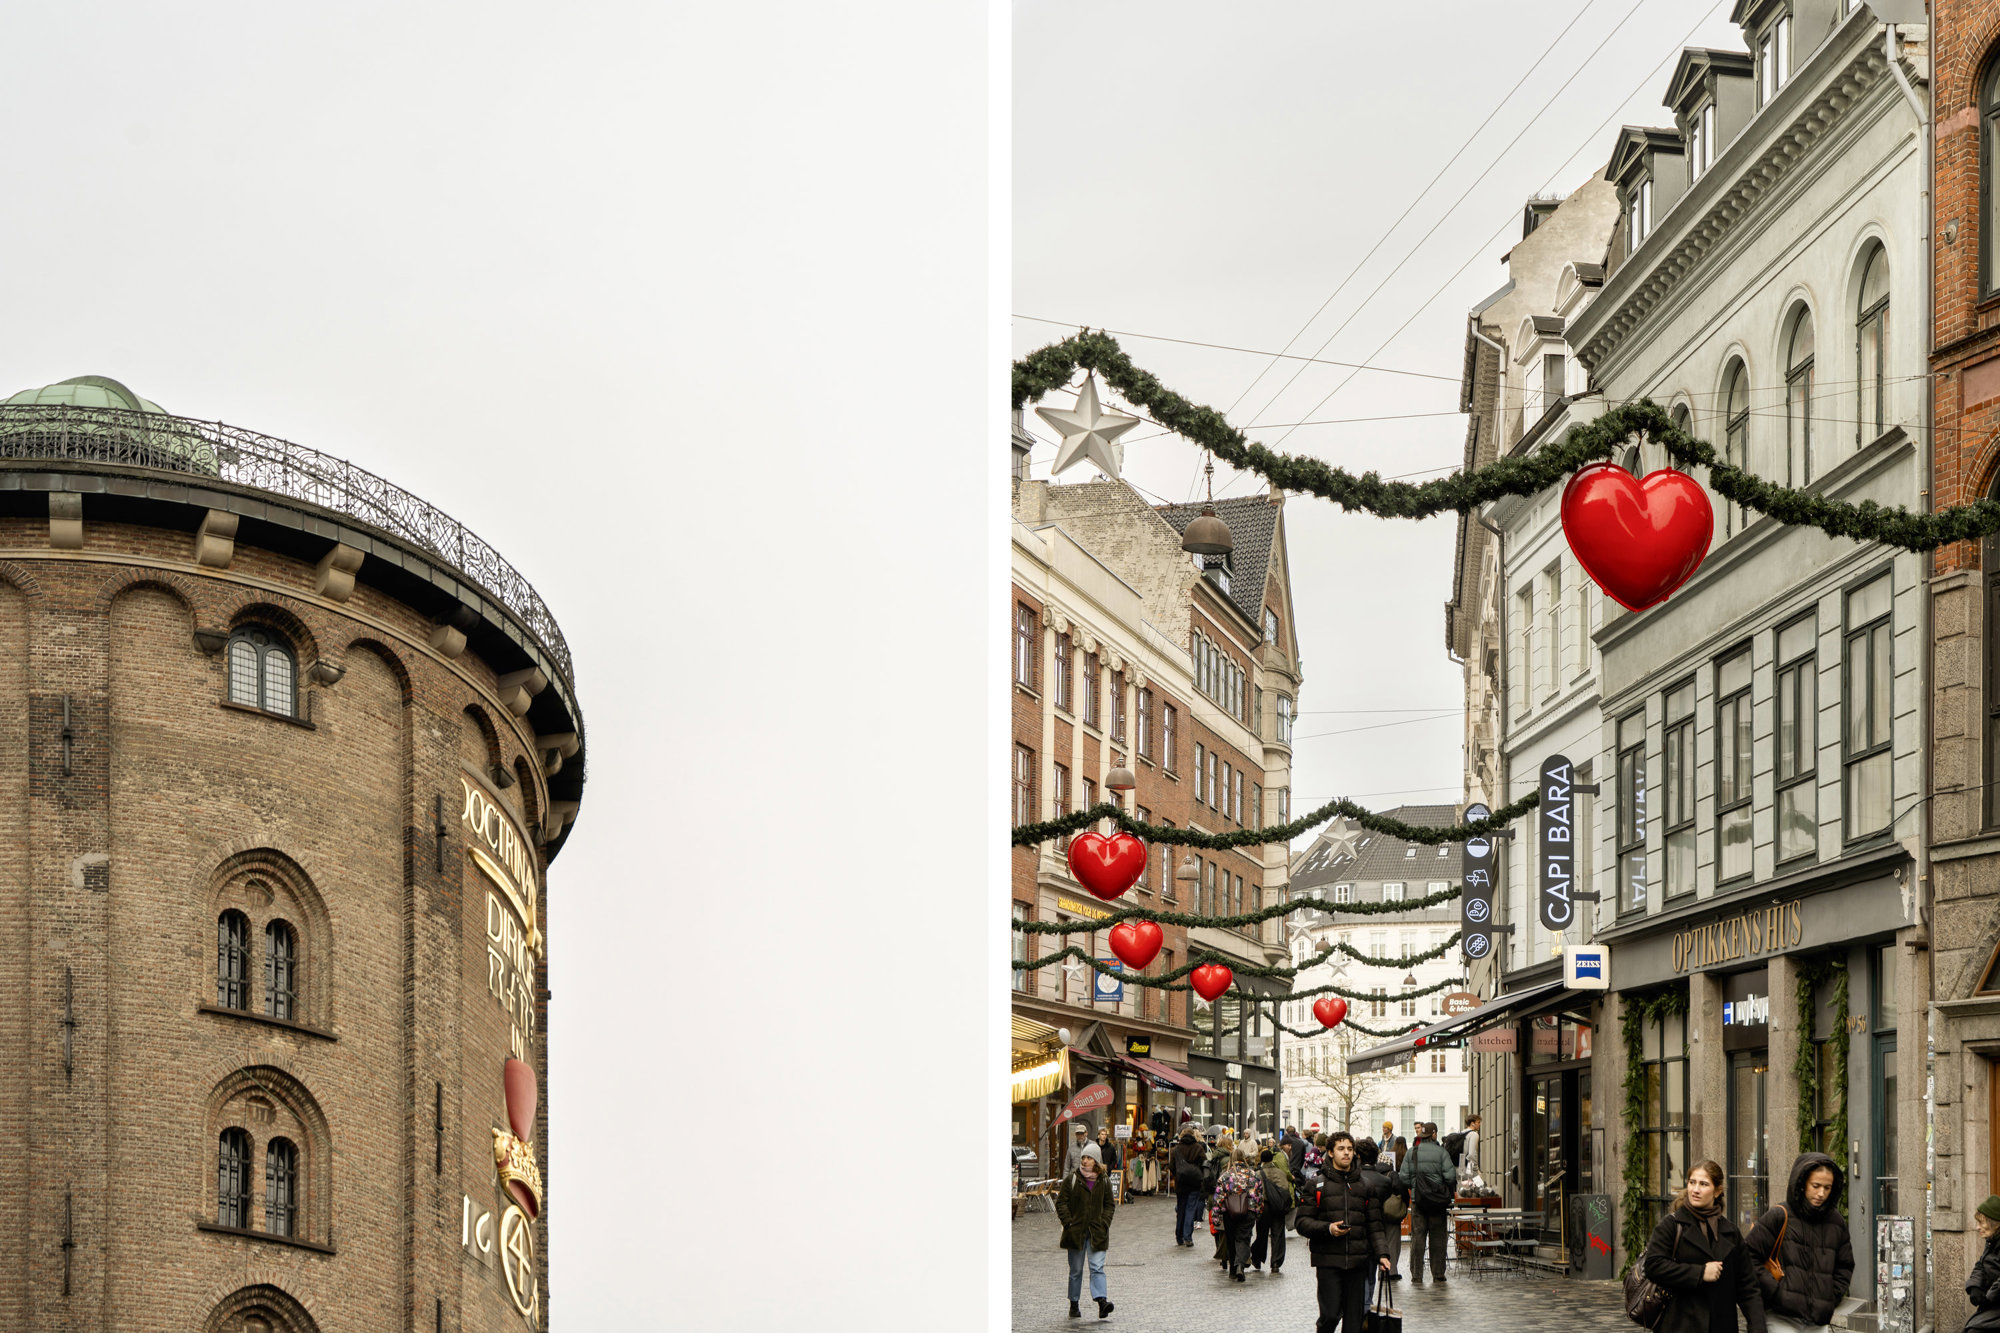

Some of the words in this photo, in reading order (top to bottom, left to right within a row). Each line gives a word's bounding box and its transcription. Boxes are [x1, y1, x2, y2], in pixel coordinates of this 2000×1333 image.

[1546, 763, 1570, 842] BARA
[1546, 856, 1571, 923] CAPI
[1672, 910, 1761, 972] OPTIKKENS
[1765, 899, 1802, 951] HUS
[1449, 998, 1469, 1006] Basic
[1478, 1036, 1512, 1045] kitchen
[1073, 1095, 1095, 1108] China
[1093, 1089, 1109, 1101] box
